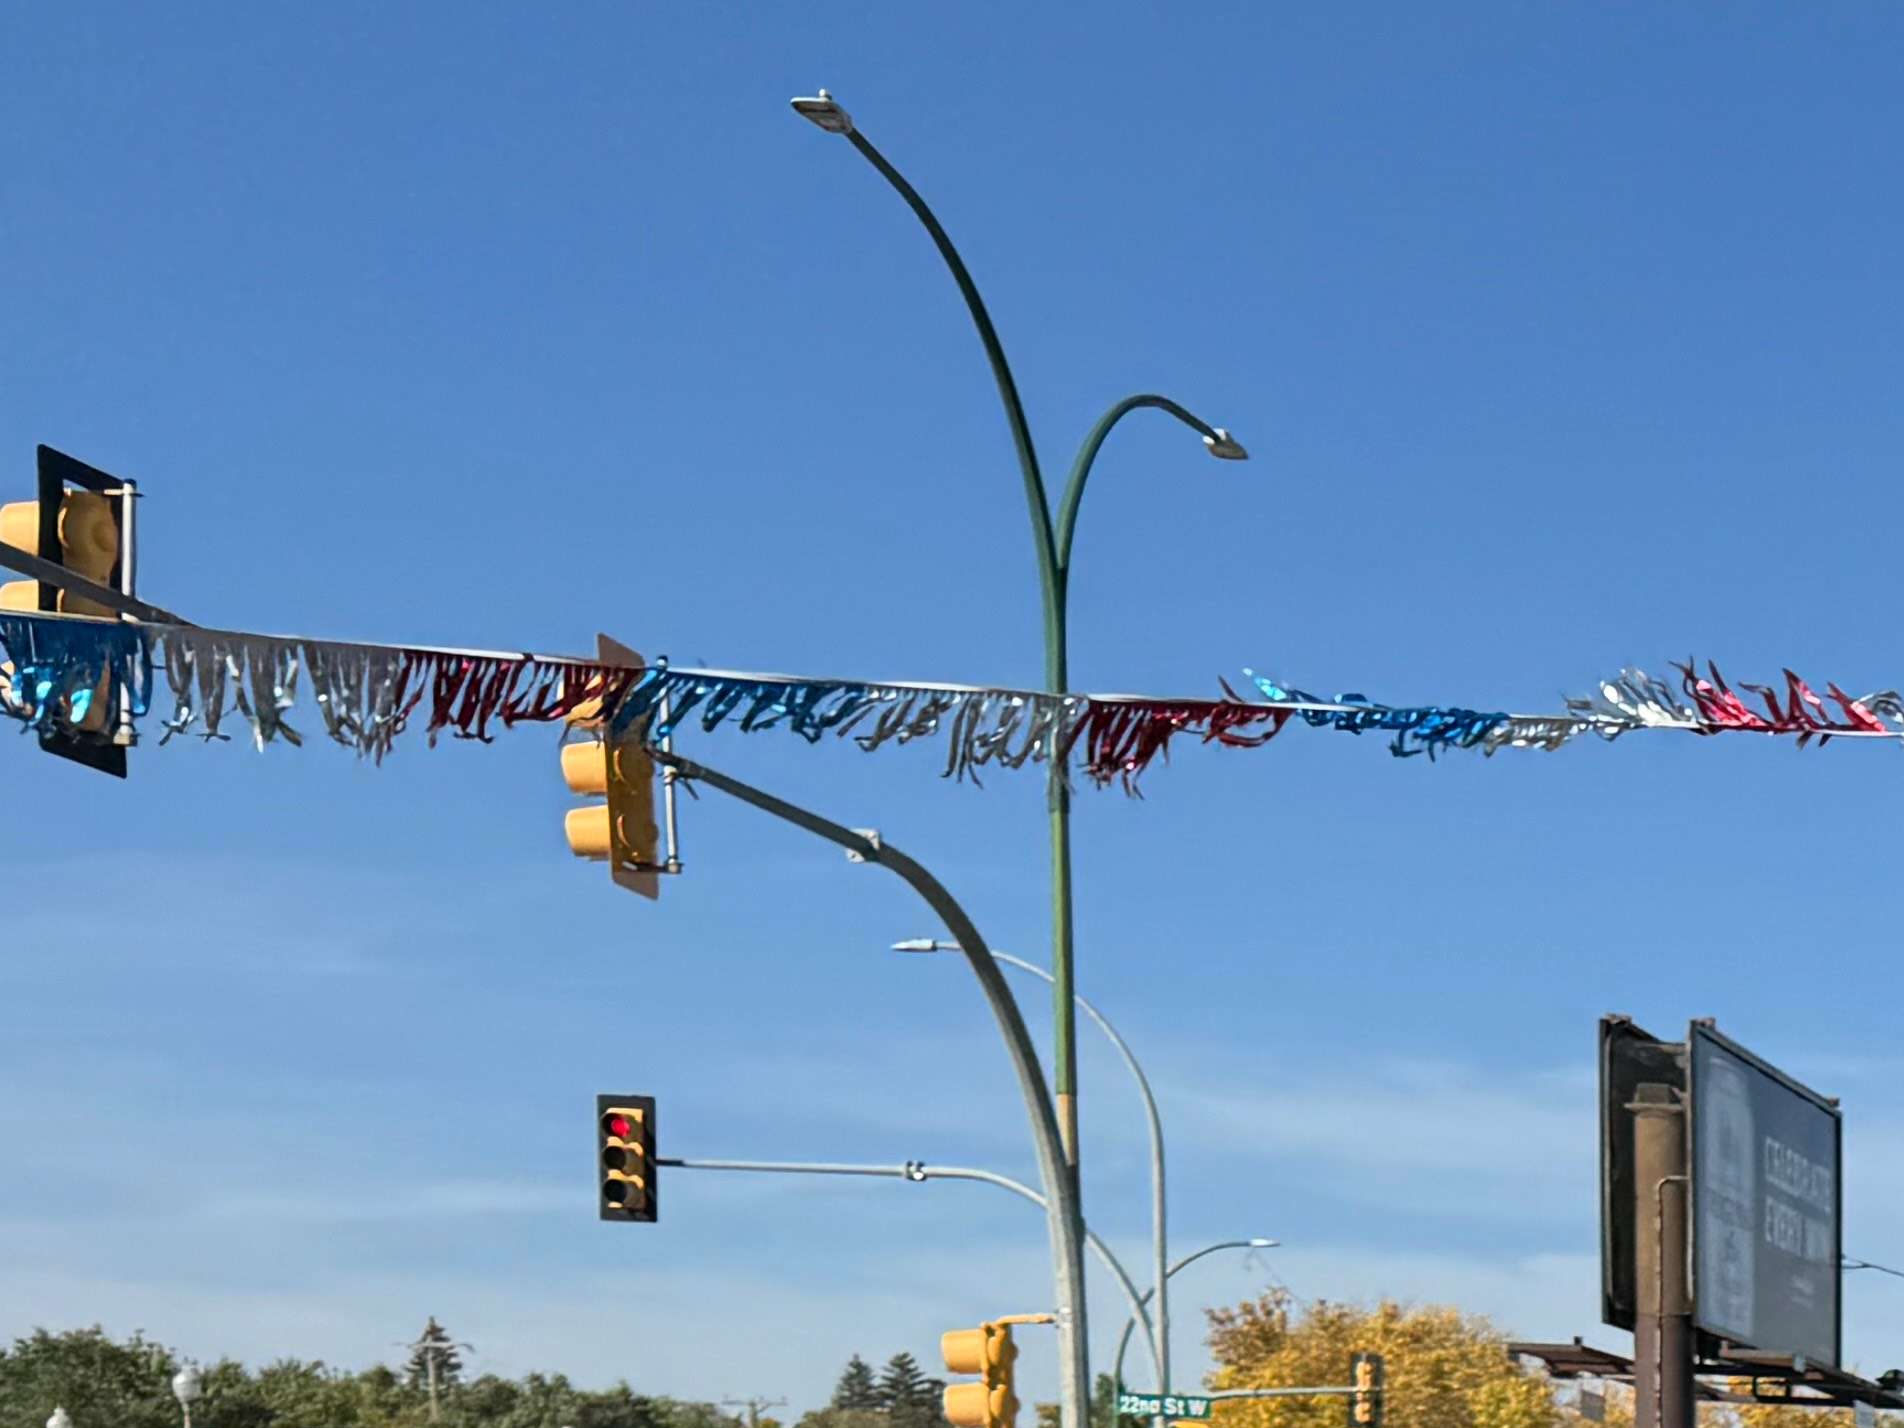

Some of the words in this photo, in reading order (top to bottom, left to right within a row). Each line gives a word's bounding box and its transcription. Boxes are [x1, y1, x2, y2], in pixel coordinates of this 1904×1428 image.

[1119, 1395, 1160, 1414] 22nd
[1163, 1397, 1185, 1415] St
[1188, 1399, 1208, 1416] W
